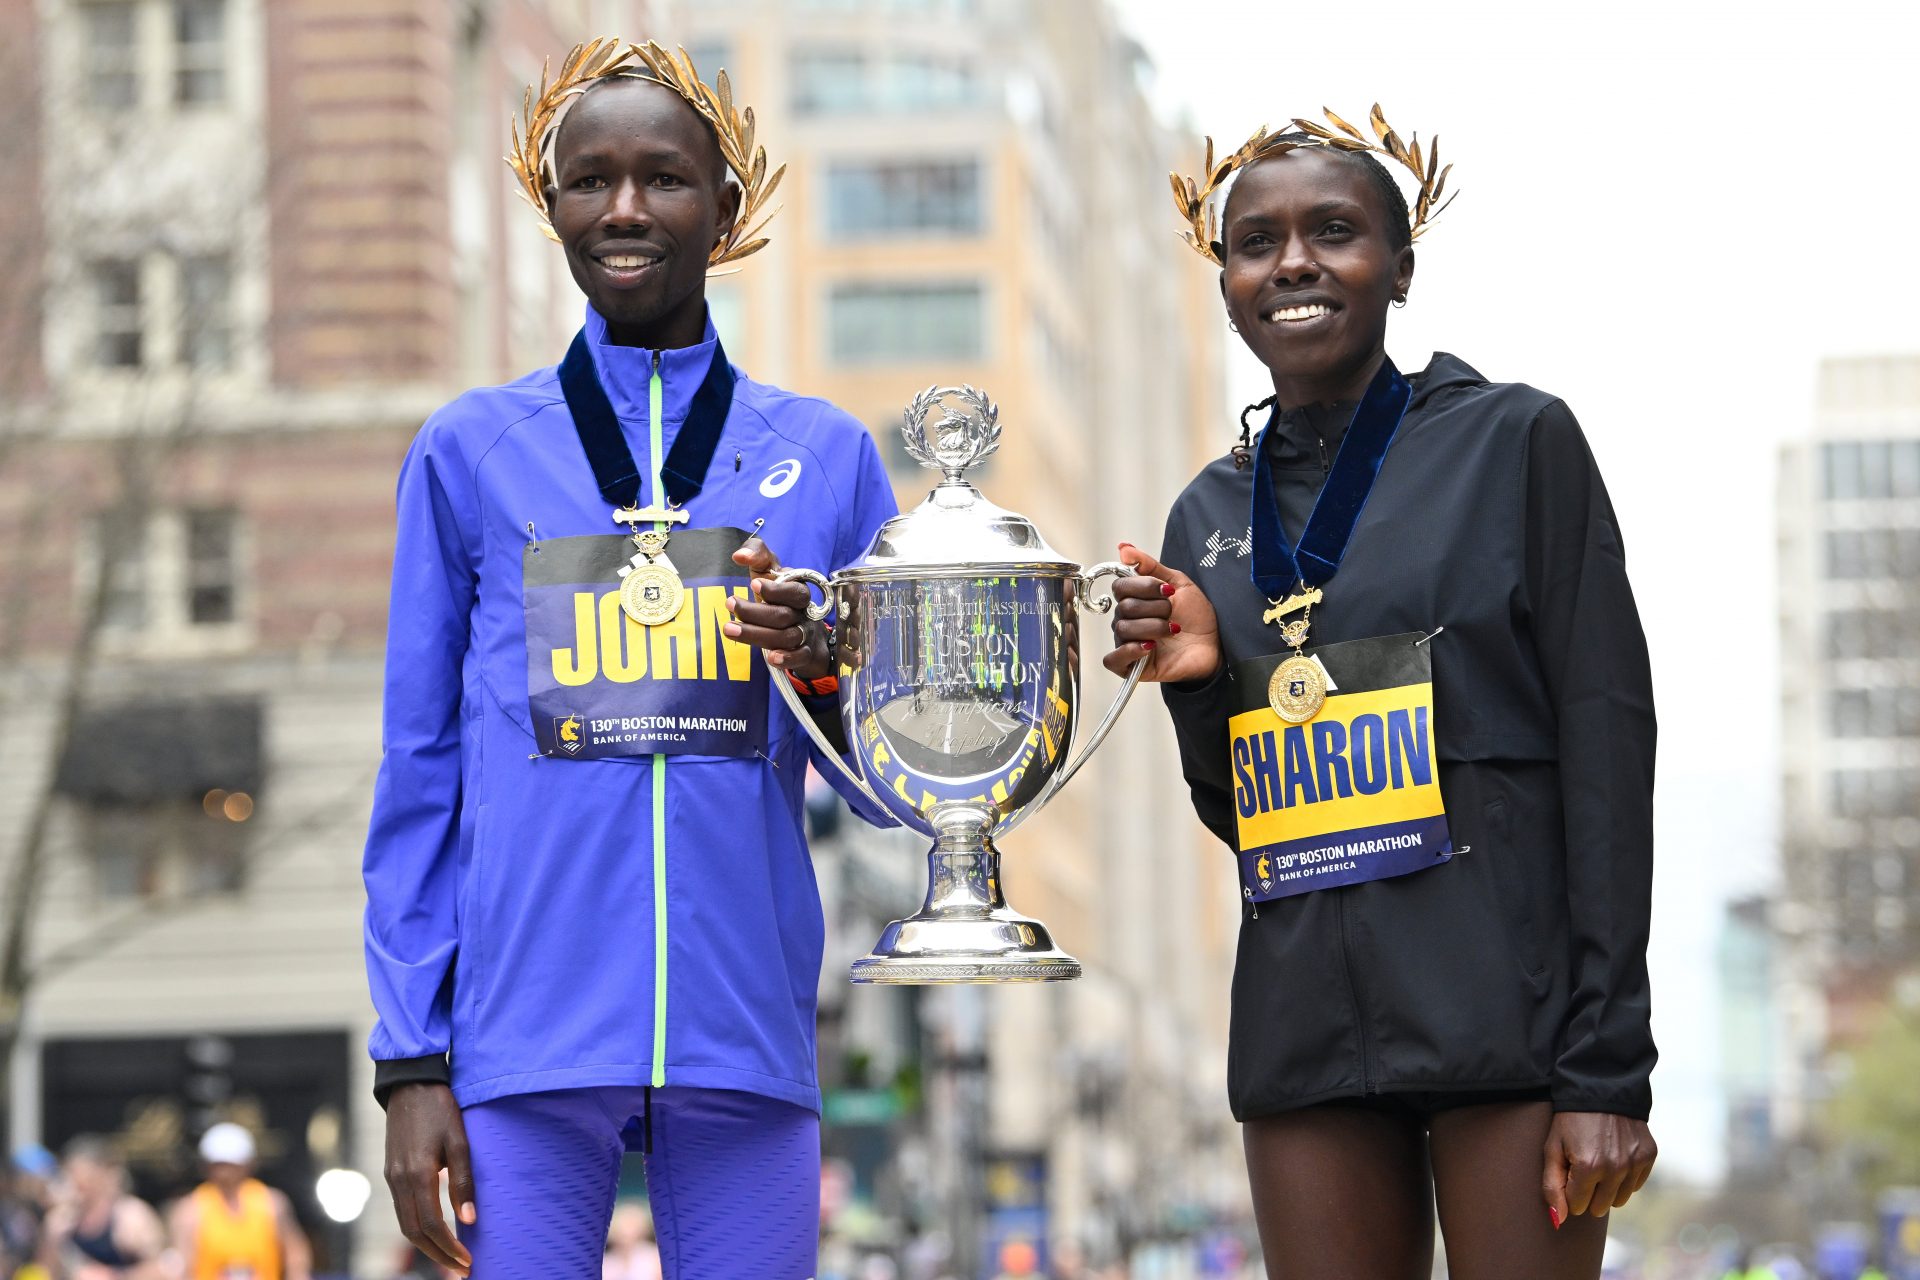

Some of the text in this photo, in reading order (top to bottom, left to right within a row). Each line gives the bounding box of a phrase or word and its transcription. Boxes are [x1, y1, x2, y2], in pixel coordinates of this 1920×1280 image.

[870, 604, 916, 619] BOSTON
[991, 601, 1060, 616] ASSOCIATION
[551, 586, 751, 686] JOHN
[919, 633, 1019, 656] BOSTON
[896, 662, 1042, 687] MARATHON
[590, 716, 748, 733] 130TH BOSTON MARATHON
[593, 733, 686, 744] BANK OF AMERICA
[1232, 706, 1433, 819] SHARON
[1276, 832, 1423, 870] 130TH BOSTON MARATHON
[1279, 861, 1357, 881] BANK OF AMERICA
